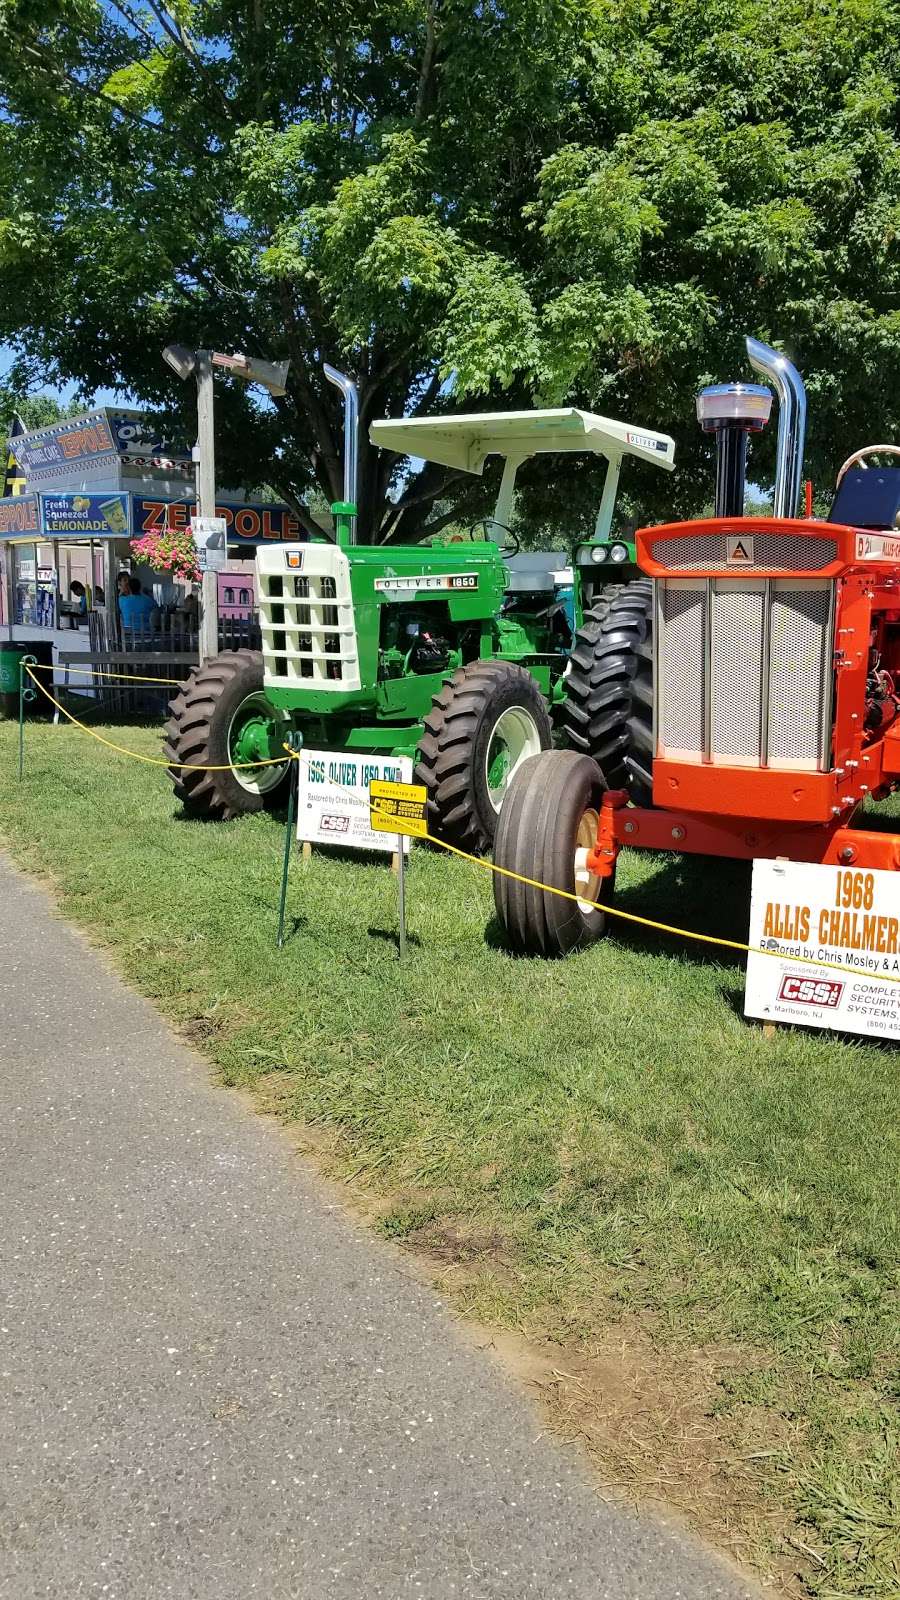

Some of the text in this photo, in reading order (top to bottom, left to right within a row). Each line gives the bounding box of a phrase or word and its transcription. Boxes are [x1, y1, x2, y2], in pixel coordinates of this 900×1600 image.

[631, 436, 656, 447] OLIVER
[45, 500, 69, 509] Fresh
[45, 510, 89, 521] Squeezed
[46, 521, 108, 531] LEMONADE
[384, 577, 474, 588] OLIVER 1850
[329, 761, 357, 787] OLIVER
[379, 789, 408, 797] PROTECTED
[322, 816, 344, 831] CSS
[836, 871, 874, 911] 1968
[764, 903, 900, 955] ALLIS CHALMER
[804, 948, 815, 960] by
[818, 949, 842, 964] Chris
[846, 953, 880, 972] Mosley
[883, 959, 889, 971] &
[782, 979, 831, 1003] CSS
[813, 1011, 823, 1019] NJ
[847, 1005, 899, 1020] SYSTEMS,
